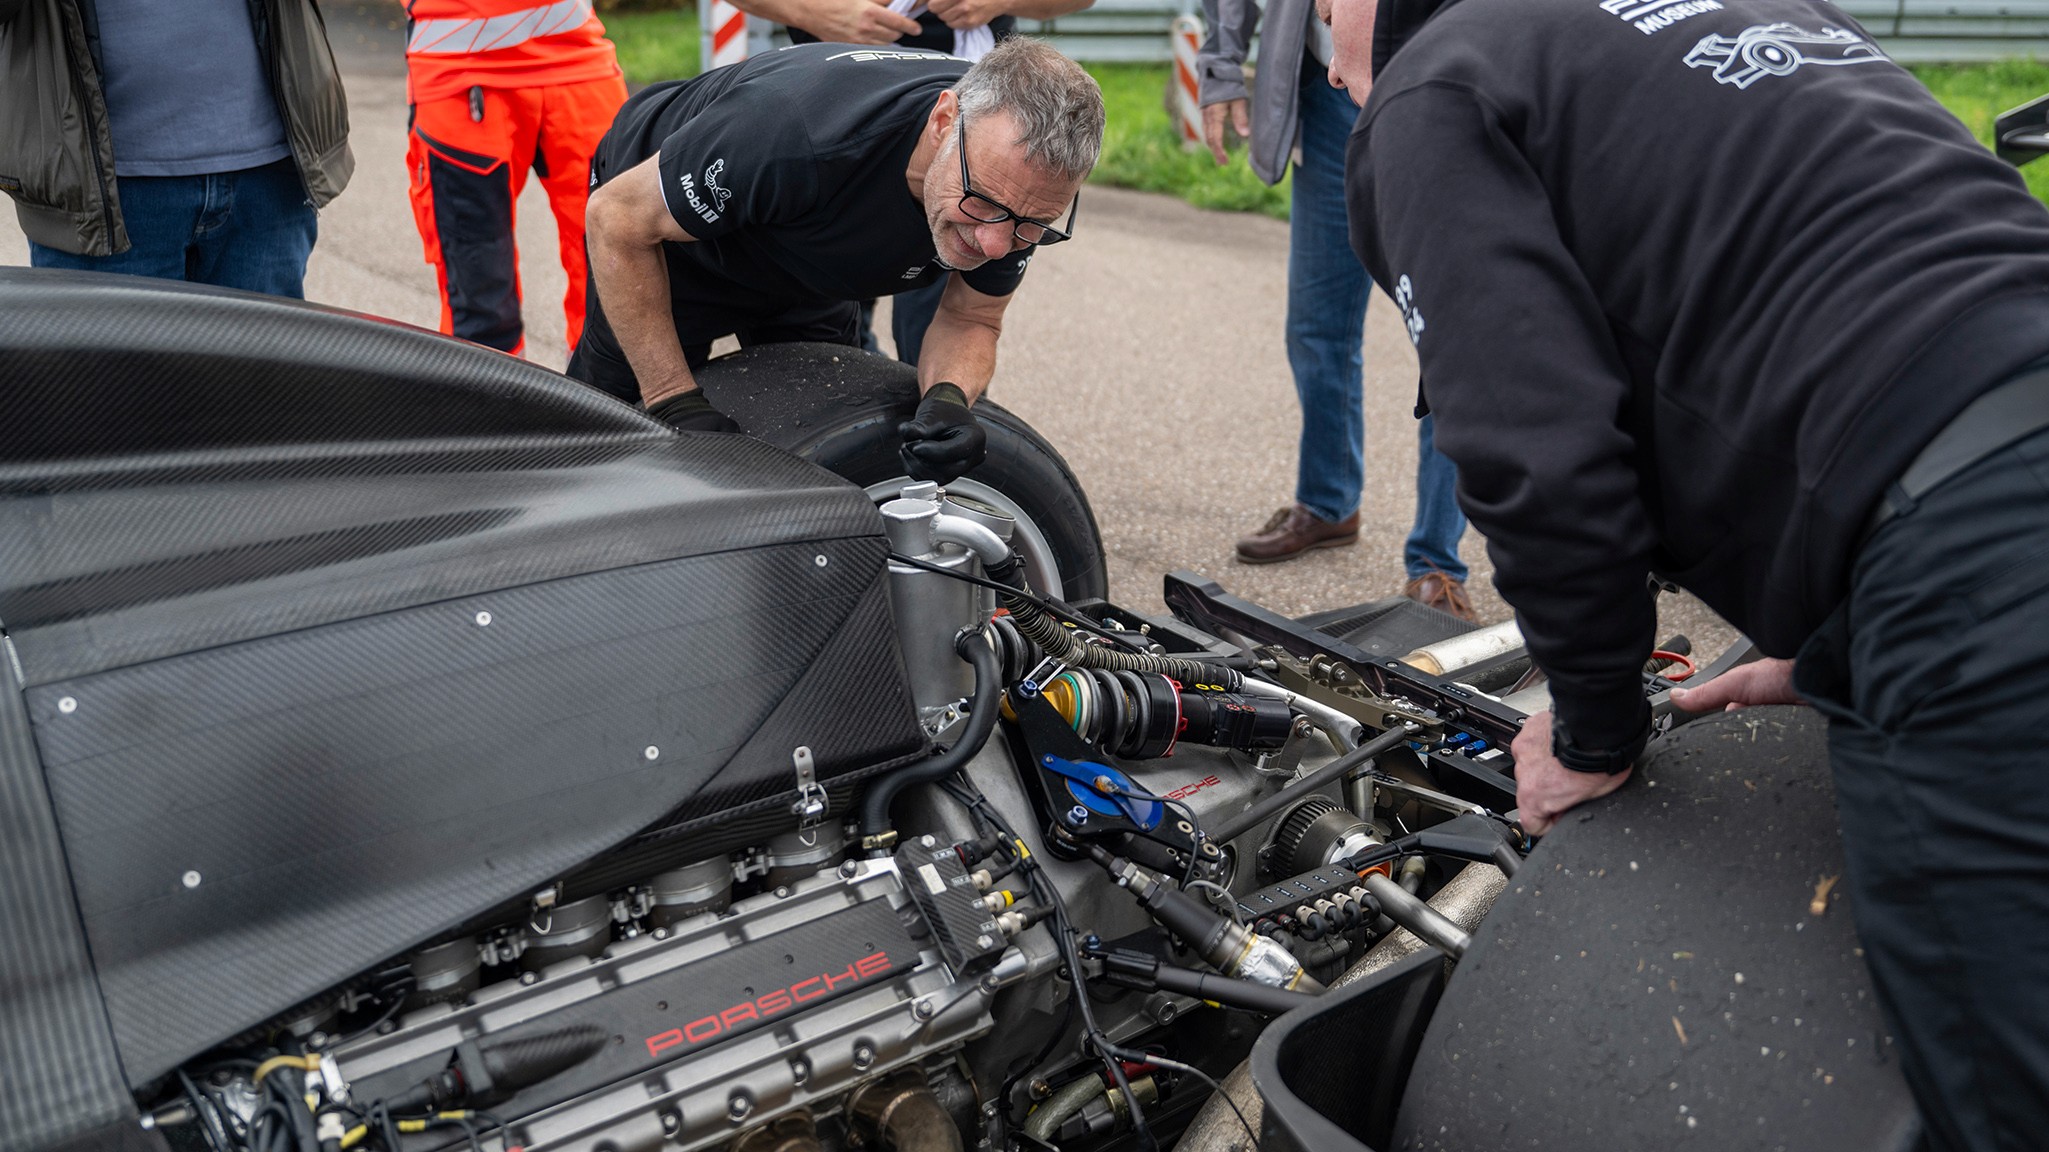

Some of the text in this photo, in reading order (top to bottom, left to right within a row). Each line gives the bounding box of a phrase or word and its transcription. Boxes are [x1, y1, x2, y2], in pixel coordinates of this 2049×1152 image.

[1633, 0, 1725, 36] MUSEUM
[680, 172, 709, 215] Mobil
[1160, 774, 1222, 801] SCHE
[644, 951, 893, 1058] PORSCHE
